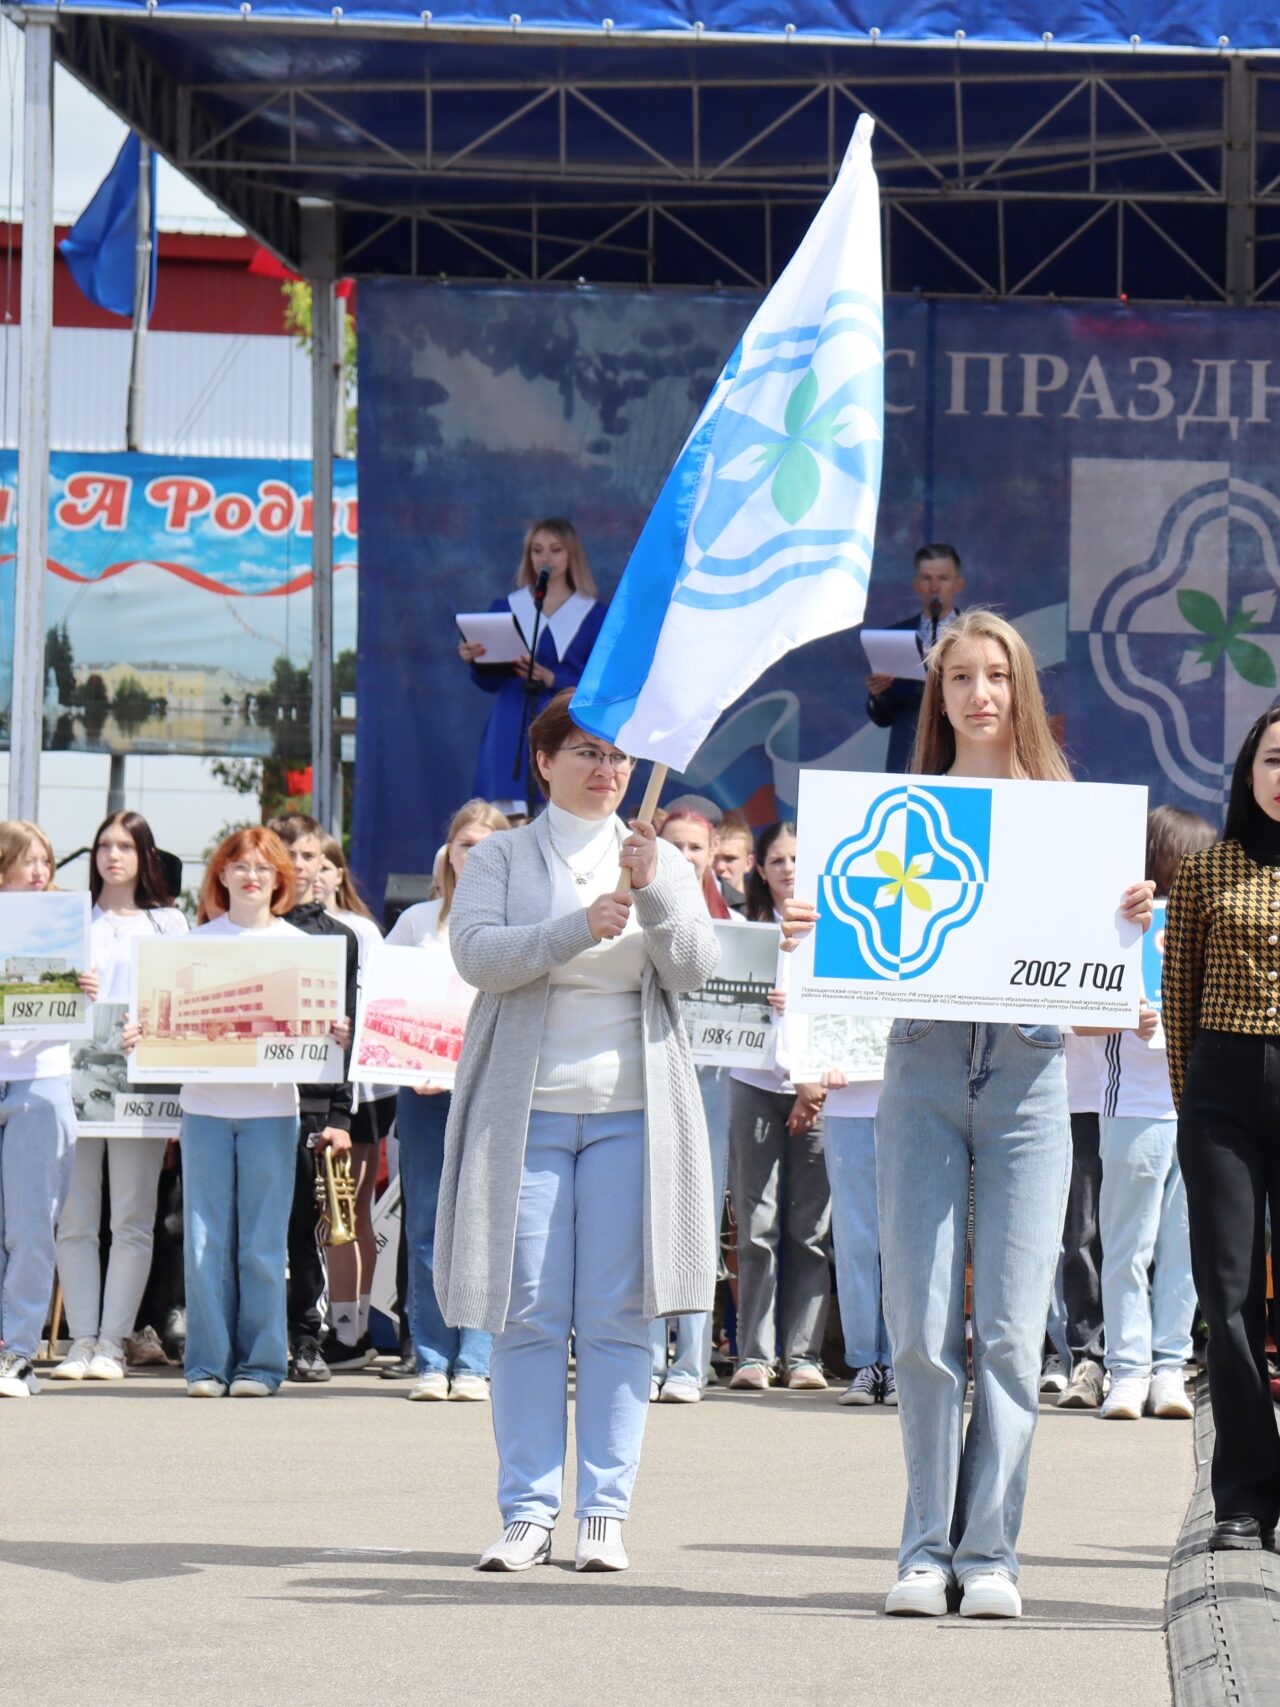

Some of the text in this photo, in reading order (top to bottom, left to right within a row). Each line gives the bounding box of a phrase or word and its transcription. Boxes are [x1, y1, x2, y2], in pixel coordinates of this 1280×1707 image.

[884, 348, 917, 414] С
[57, 473, 131, 529] А
[1009, 960, 1071, 987] 2002
[1079, 962, 1125, 992] ГОД
[11, 1000, 77, 1017] 1987 ГОД
[702, 1027, 766, 1048] 1984 ГОД
[264, 1043, 329, 1061] 1986 ГОД
[123, 1101, 154, 1116] 1963
